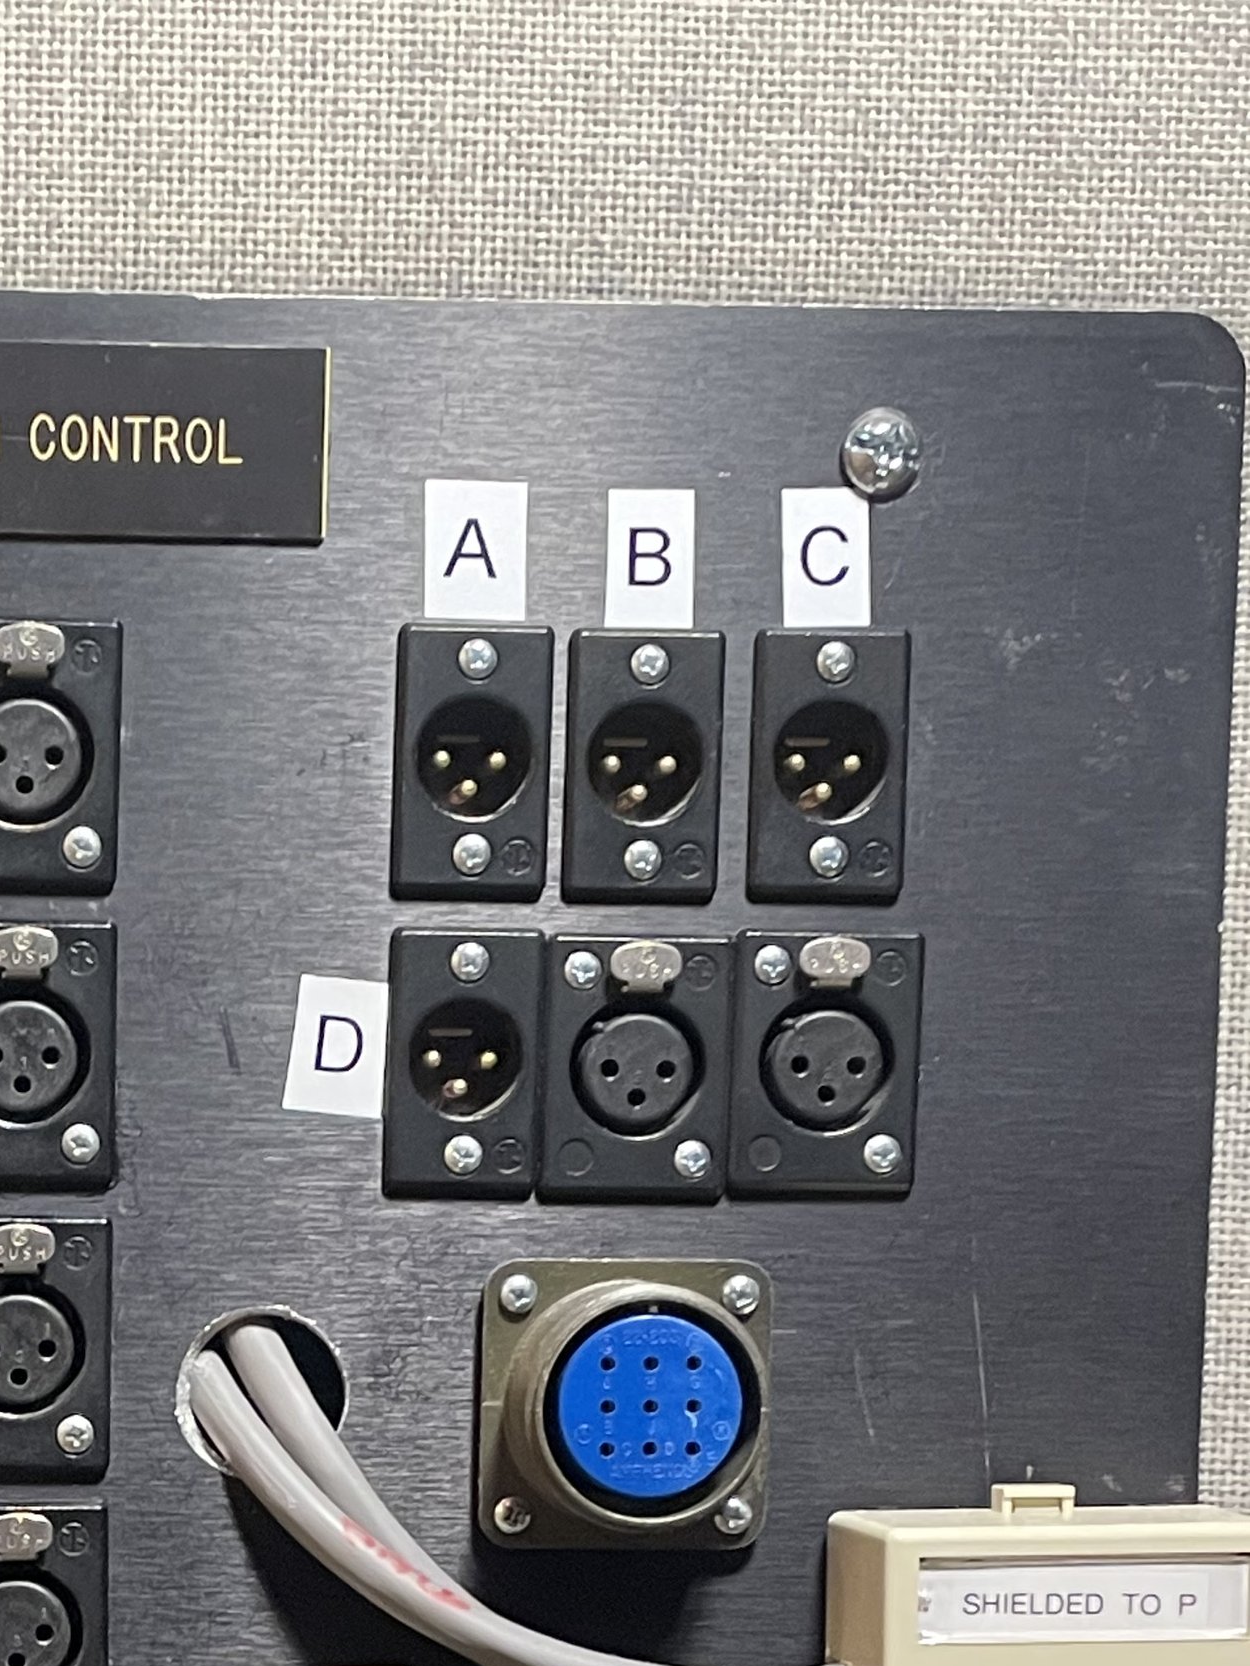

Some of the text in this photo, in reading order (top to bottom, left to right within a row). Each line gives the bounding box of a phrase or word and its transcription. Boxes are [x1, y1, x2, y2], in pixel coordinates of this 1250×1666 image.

[29, 413, 244, 465] CONTROL
[443, 518, 497, 579] A
[628, 527, 672, 587] B
[800, 525, 850, 587] C
[314, 1014, 363, 1073] D
[962, 1592, 1197, 1616] SHIELDED TO P
